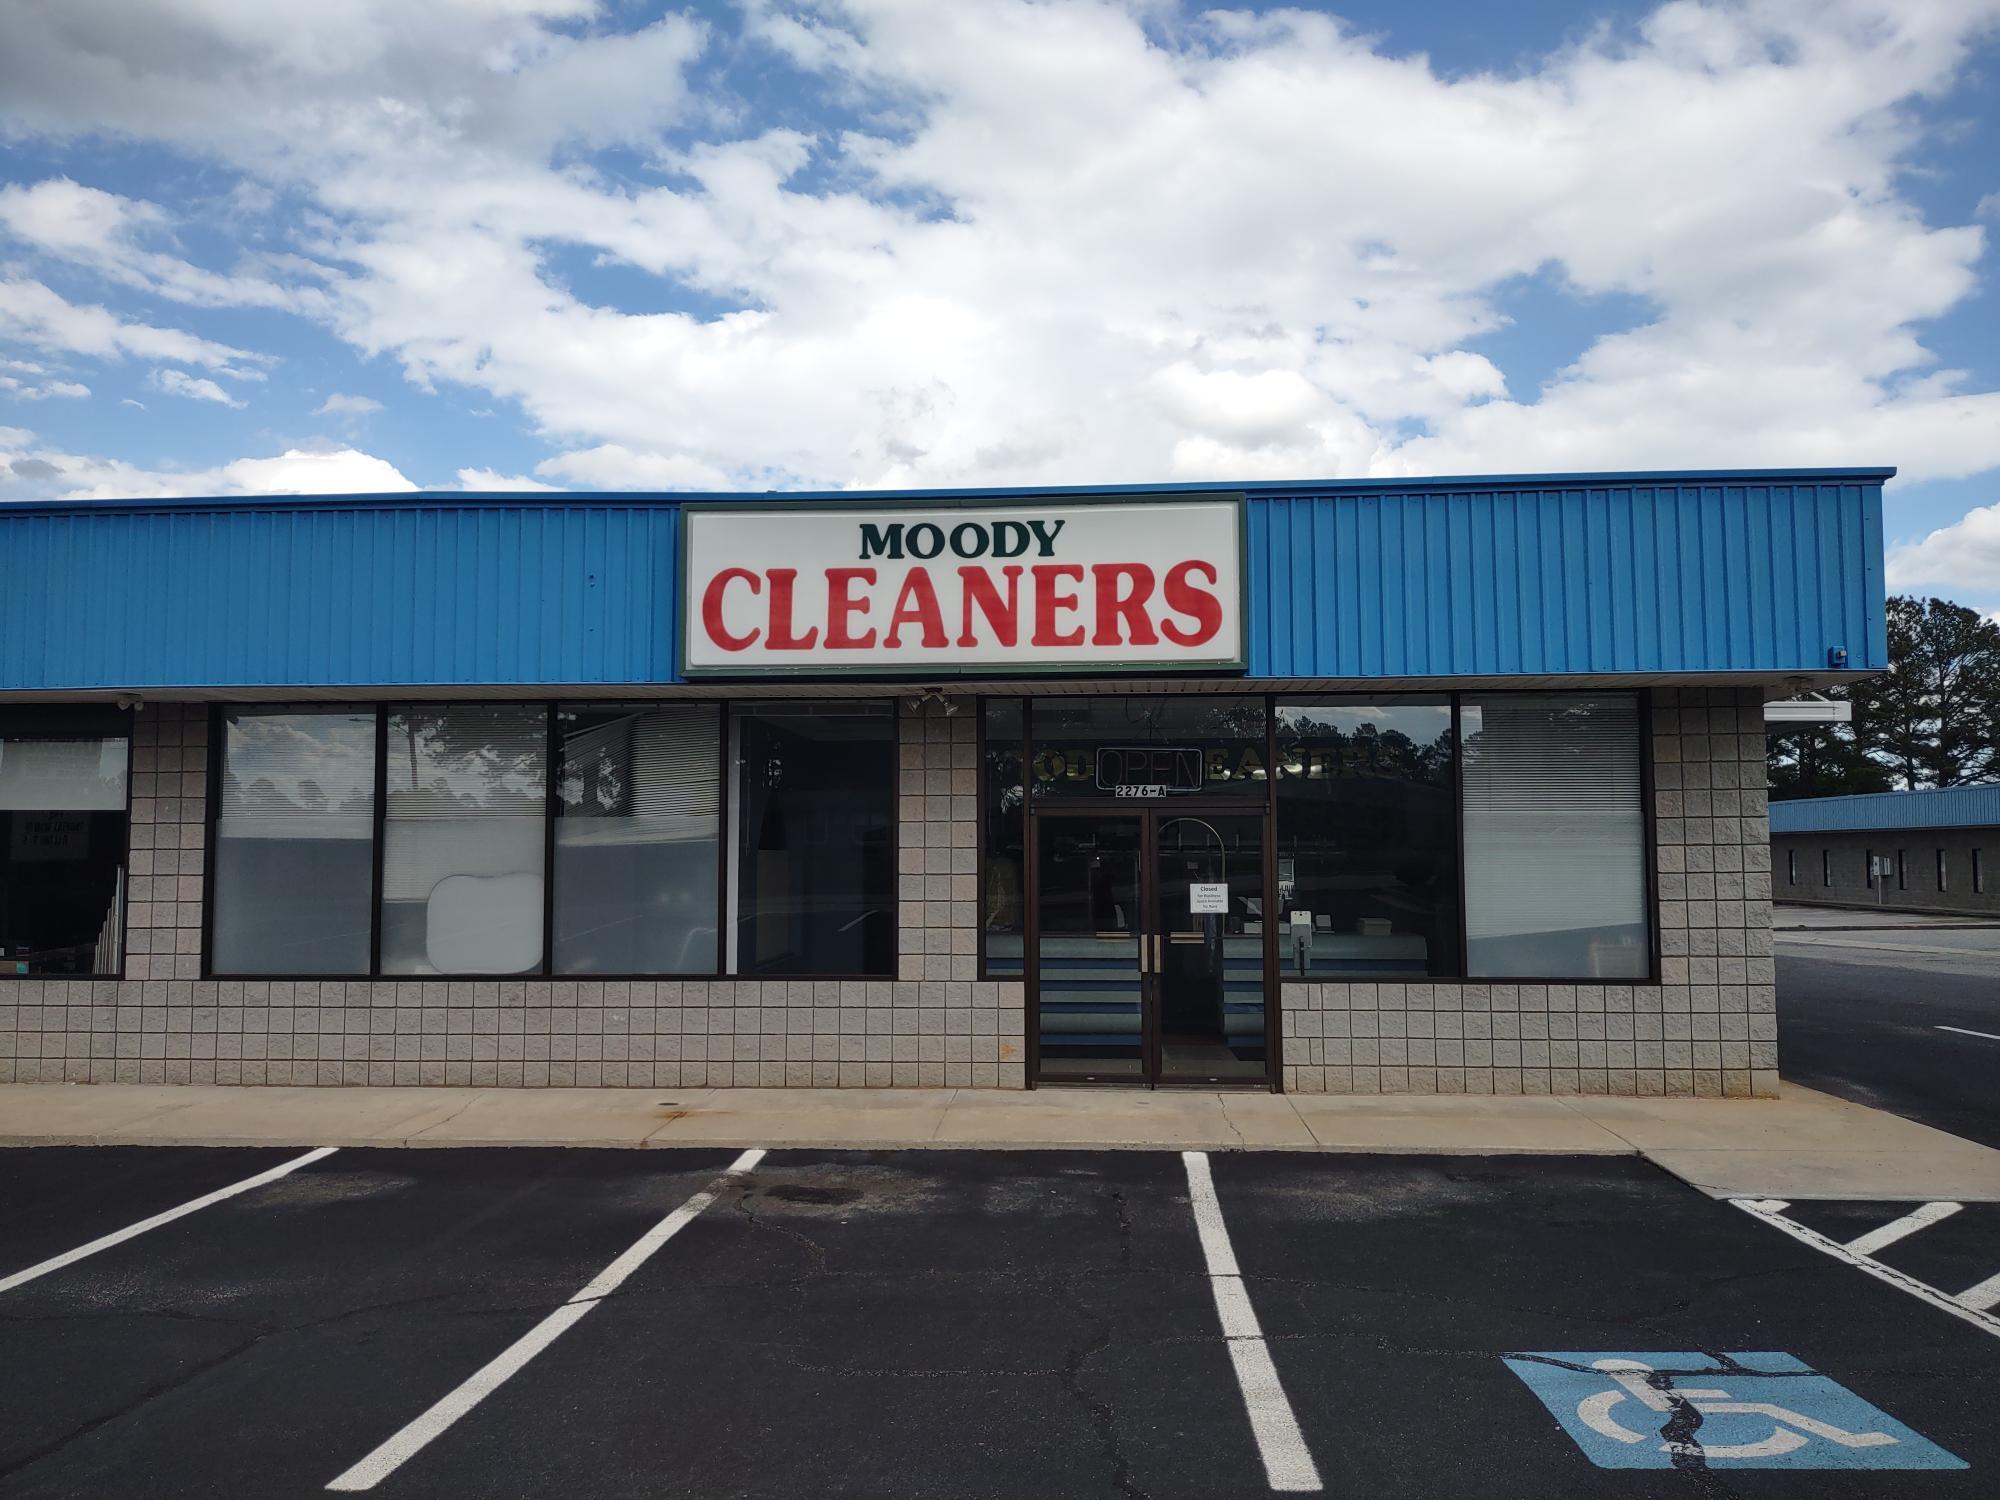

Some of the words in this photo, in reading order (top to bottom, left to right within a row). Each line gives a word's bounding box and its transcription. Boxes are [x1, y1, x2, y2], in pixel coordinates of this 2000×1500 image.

[859, 519, 1066, 560] MOODY
[702, 559, 1224, 652] CLEANERS
[1100, 750, 1200, 788] OPEN
[1116, 785, 1166, 797] 2276-A
